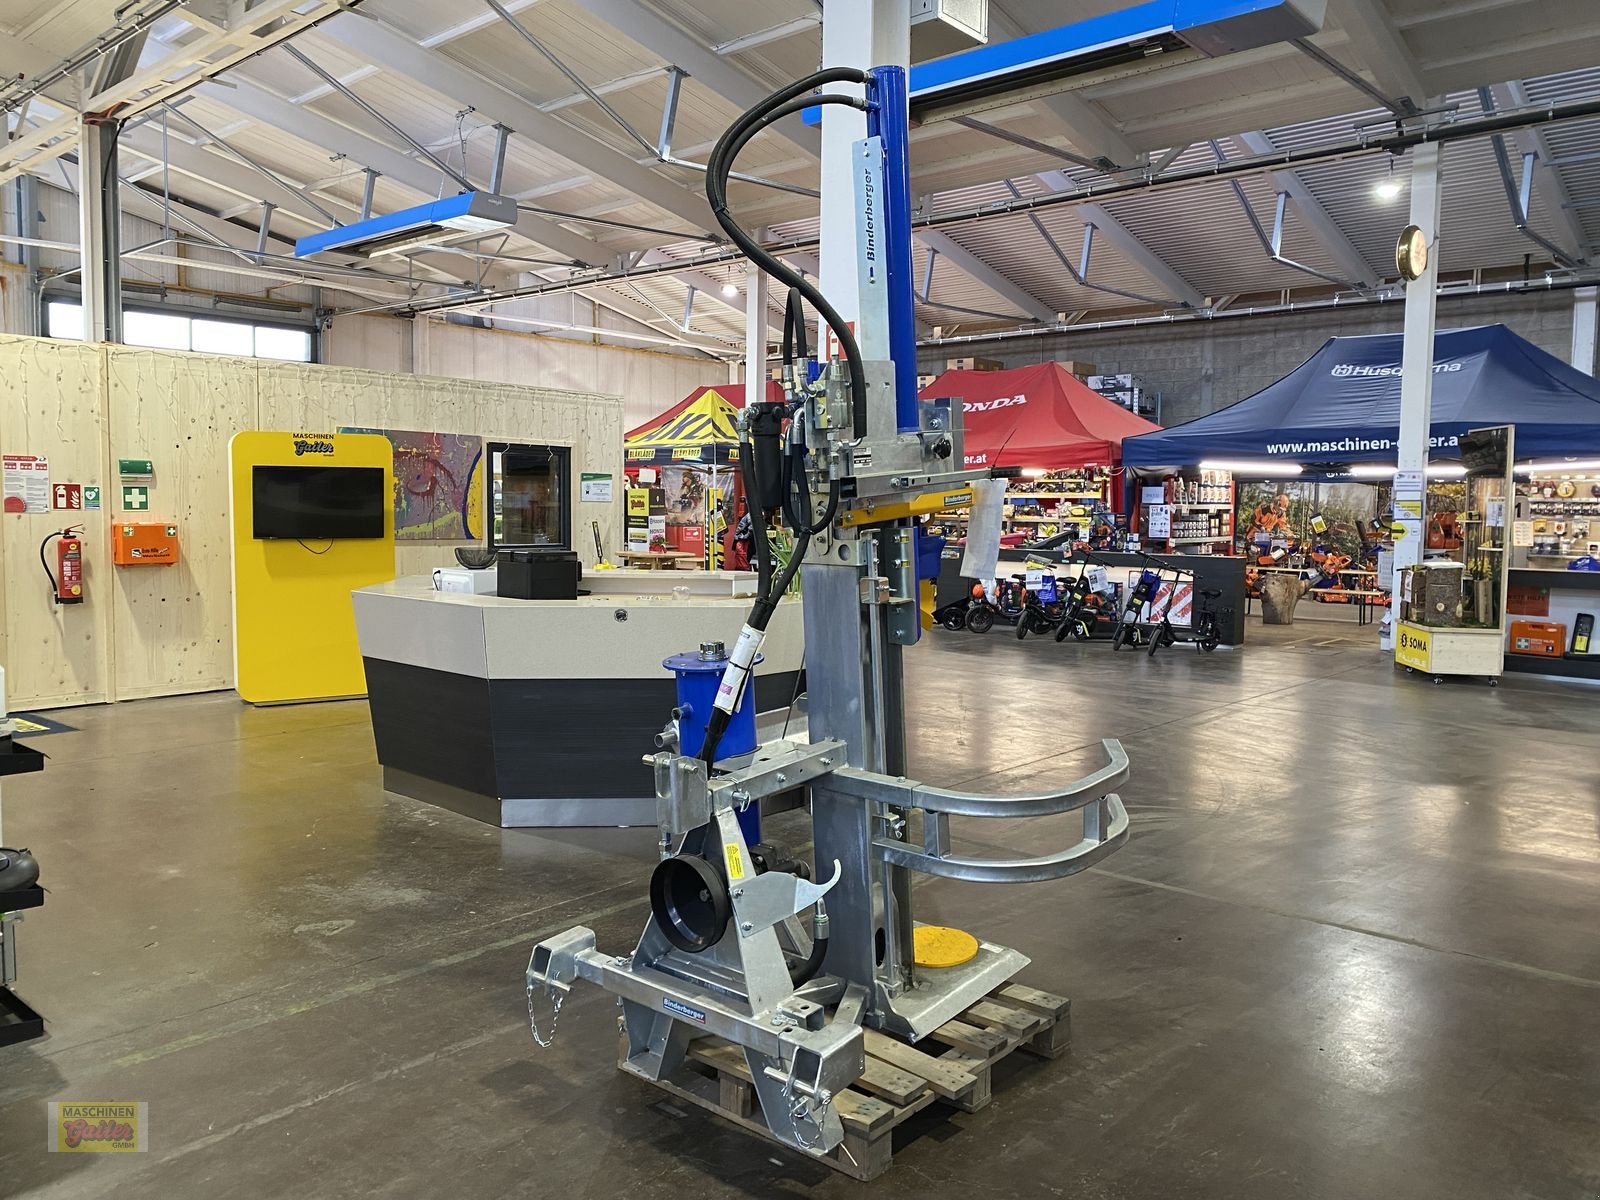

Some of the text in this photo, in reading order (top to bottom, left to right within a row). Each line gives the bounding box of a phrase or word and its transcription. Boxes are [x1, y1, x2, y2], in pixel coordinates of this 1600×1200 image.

[864, 168, 875, 261] Binderberger
[1353, 363, 1462, 377] Husqna
[963, 394, 1027, 412] NDA
[1267, 434, 1464, 454] www.maschinen-er.a
[1409, 636, 1427, 652] SOMA
[664, 998, 704, 1019] Binderberger
